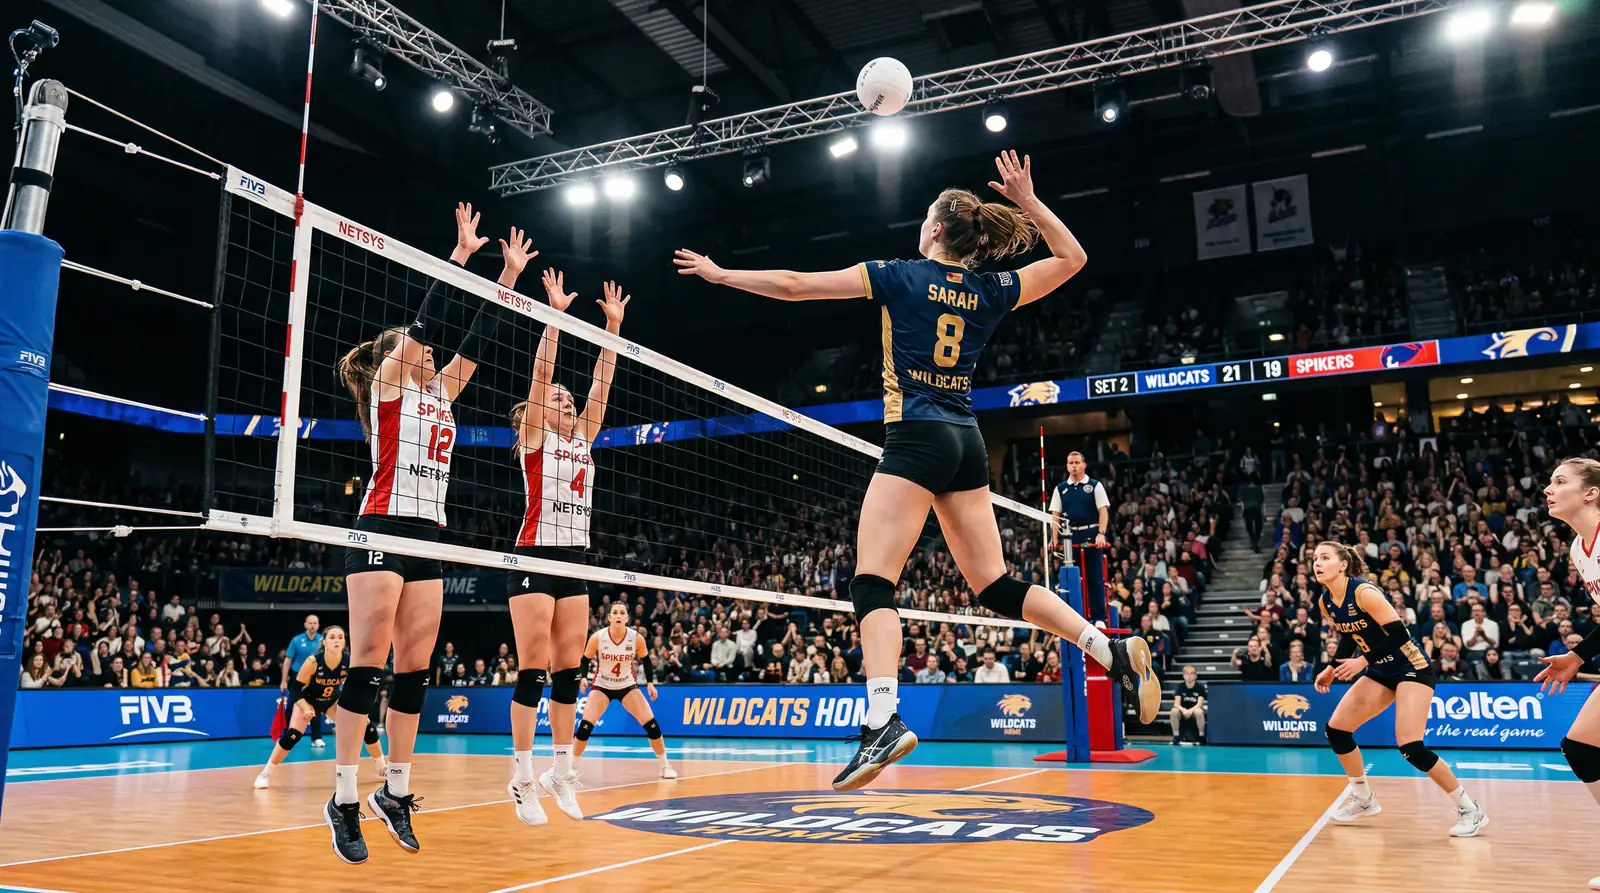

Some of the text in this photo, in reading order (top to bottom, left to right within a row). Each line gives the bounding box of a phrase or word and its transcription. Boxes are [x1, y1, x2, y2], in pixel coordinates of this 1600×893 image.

[240, 175, 266, 195] FIVB
[339, 221, 385, 250] NETSYS
[498, 290, 532, 312] NETSYS
[928, 284, 979, 311] SARAH
[933, 313, 965, 368] 8
[20, 350, 46, 367] FIVB
[908, 369, 970, 390] WILDCATS
[1095, 354, 1354, 394] SET 2 WILDCATS 21 19 SPIKERS
[428, 424, 453, 464] 12
[570, 468, 586, 498] 4
[348, 532, 368, 543] FIVB
[368, 551, 383, 565] 12
[503, 555, 518, 565] FIVB
[253, 575, 344, 592] WILDCATS
[522, 577, 530, 588] 4
[1352, 634, 1371, 653] 8
[601, 653, 634, 661] SPIKERS
[611, 663, 621, 677] 4
[322, 687, 334, 697] 8
[120, 695, 193, 725] FIVB
[438, 714, 469, 723] WILDCATS
[683, 698, 900, 727] WILDCATS HOM
[991, 718, 1036, 729] WILDCATS
[1263, 720, 1317, 732] WILDCATS
[1436, 724, 1461, 736] the
[1464, 724, 1499, 737] real
[1500, 728, 1545, 742] game
[592, 807, 1101, 842] WILDCATS
[680, 826, 873, 842] HOME
